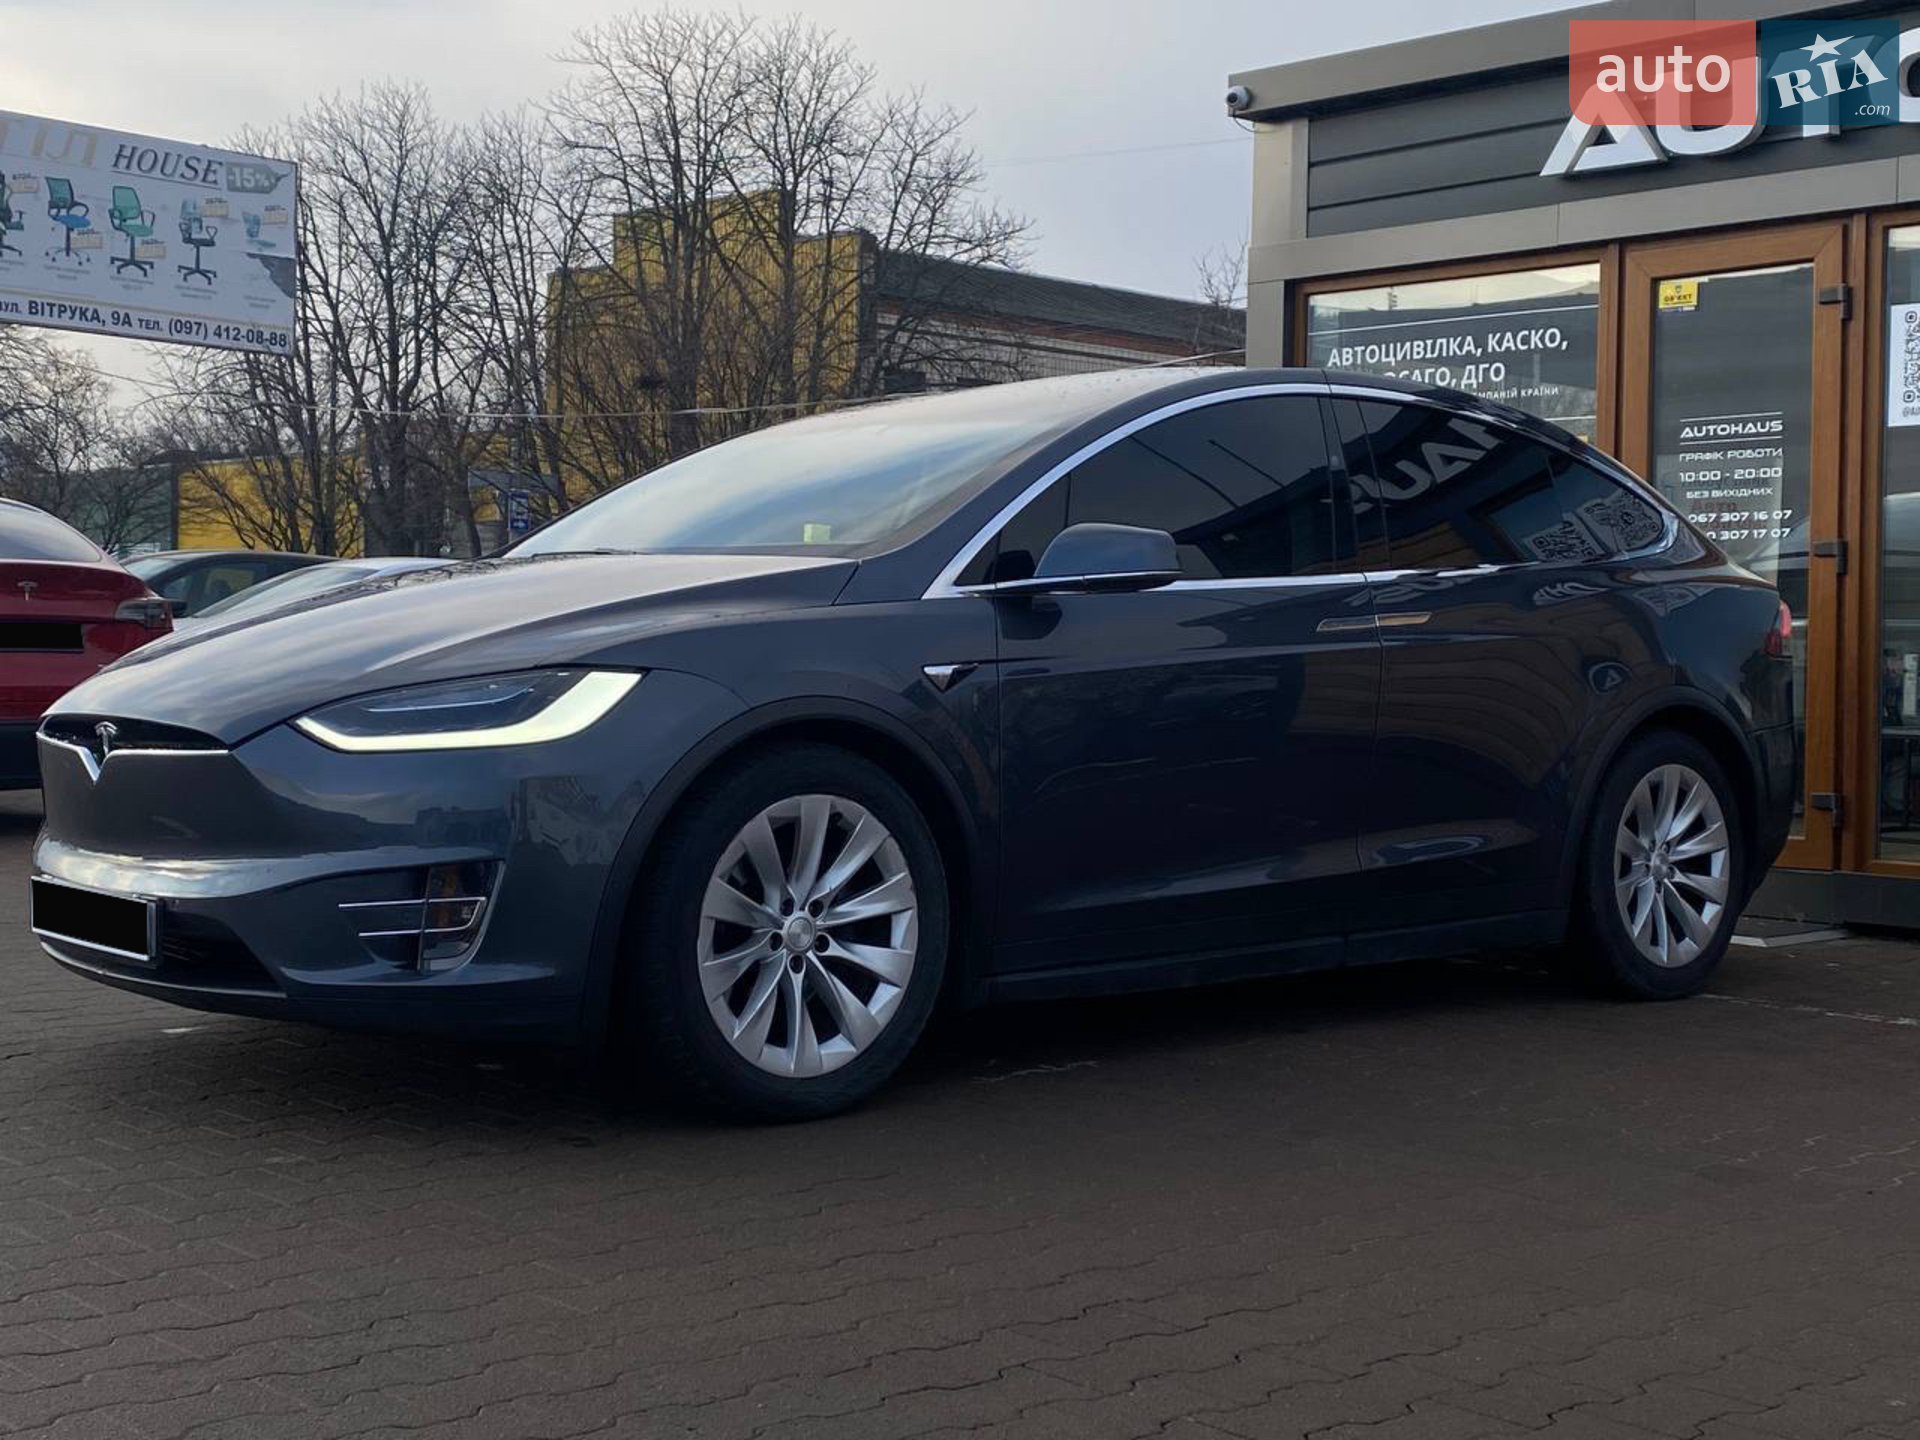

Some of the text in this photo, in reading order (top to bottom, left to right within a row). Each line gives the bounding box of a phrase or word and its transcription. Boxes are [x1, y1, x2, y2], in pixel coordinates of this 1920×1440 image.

[112, 143, 223, 186] HOUSE
[27, 299, 106, 327] ВІТРУКА,
[111, 311, 133, 328] 9А
[168, 319, 208, 340] (097)
[213, 324, 288, 348] 412-08-88
[1327, 327, 1569, 368] АВТОЦИВІЛКА, КАСКО,
[1461, 362, 1506, 389] ДГО
[1680, 420, 1783, 439] AUTOHAUS
[1679, 448, 1783, 462] ГРАФІК РОБОТИ
[1680, 470, 1721, 482] 10:00
[1734, 467, 1782, 480] 20:00
[1686, 487, 1774, 499] БЕЗ ВИХІДНИХ
[1688, 509, 1792, 523] 067 307 16 07
[1720, 530, 1750, 540] 307
[1753, 529, 1768, 539] 17
[1771, 528, 1792, 538] 07
